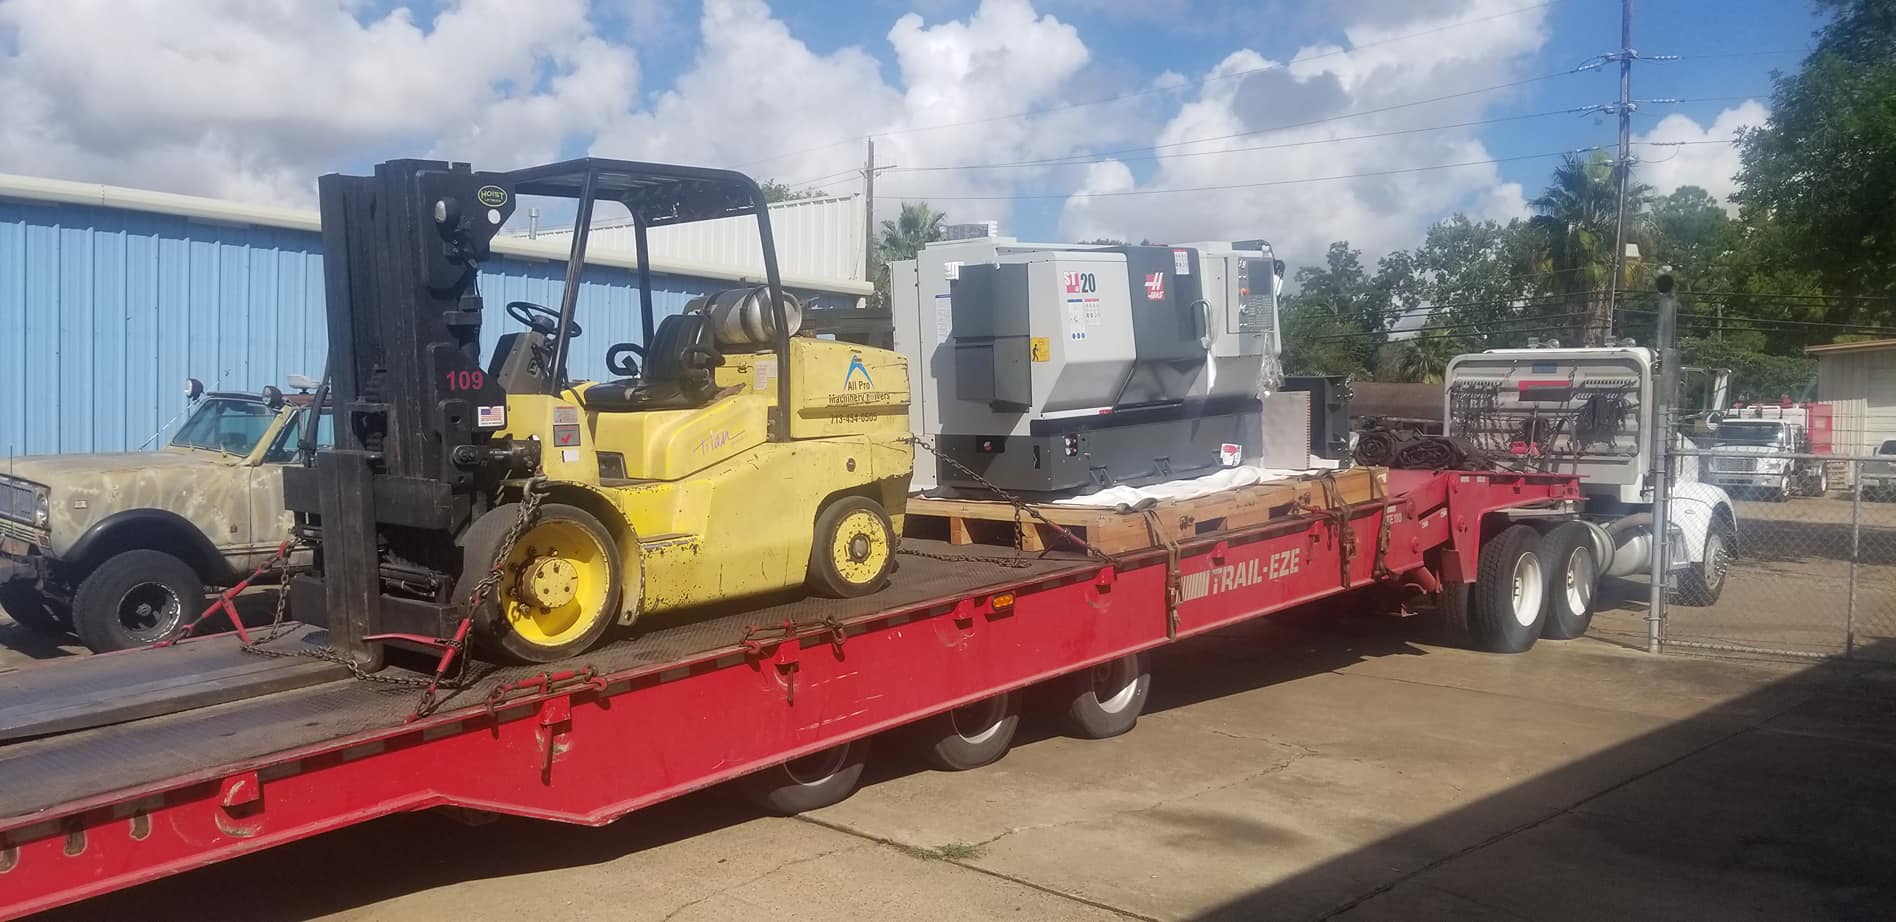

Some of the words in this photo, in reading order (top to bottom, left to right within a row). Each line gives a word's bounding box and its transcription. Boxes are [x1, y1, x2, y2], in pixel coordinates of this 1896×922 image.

[481, 190, 505, 201] HOIST
[1064, 271, 1077, 286] ST
[1080, 272, 1096, 293] 20
[446, 370, 484, 391] 109
[847, 381, 857, 391] All
[858, 380, 870, 390] Pro
